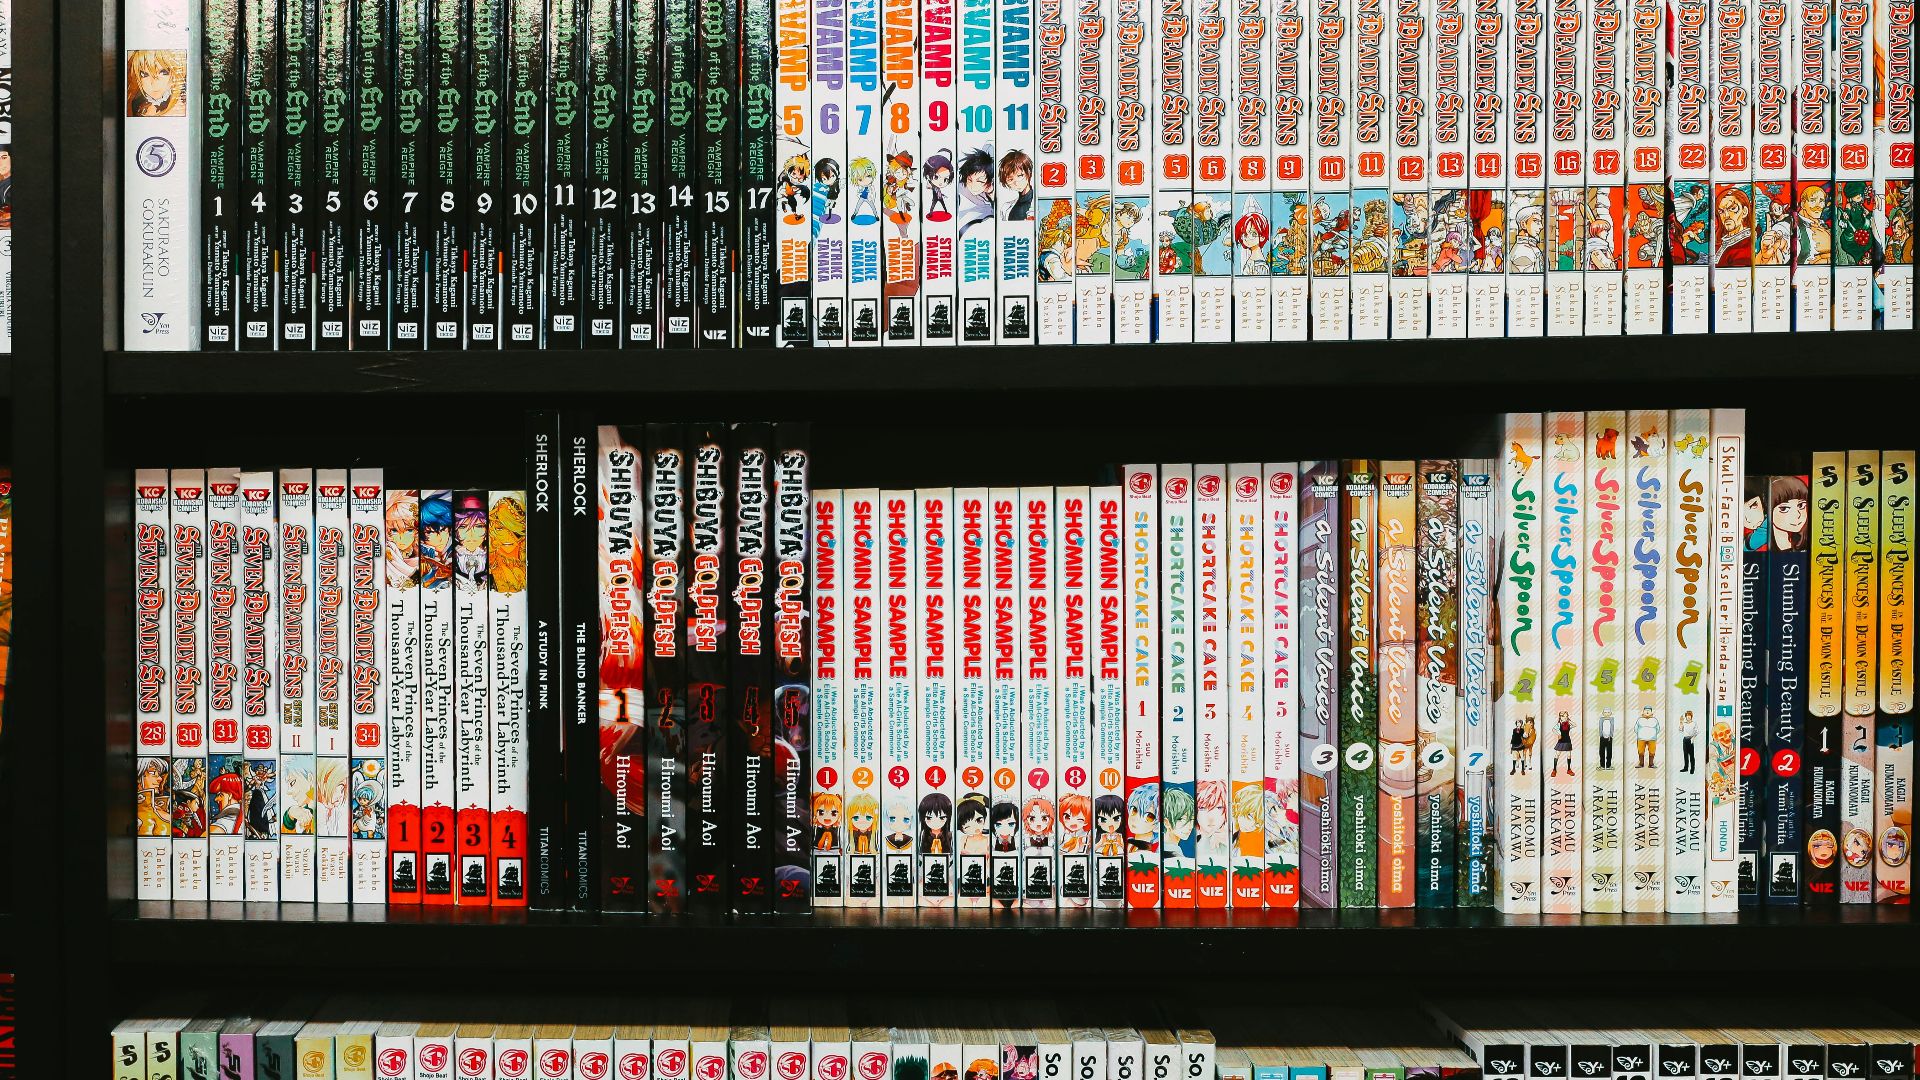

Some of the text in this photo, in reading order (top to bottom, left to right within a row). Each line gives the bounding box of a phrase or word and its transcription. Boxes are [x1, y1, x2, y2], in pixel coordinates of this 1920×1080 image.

[1632, 6, 1661, 138] DEADLY SINS
[1038, 24, 1067, 154] DEADLY SINS
[783, 105, 803, 135] 5
[819, 103, 840, 135] 6
[855, 104, 872, 135] 7
[890, 102, 910, 134] 8
[928, 100, 948, 132] 9
[961, 105, 992, 133] 10
[1002, 103, 1029, 130] 11
[144, 144, 166, 171] 5
[563, 133, 571, 178] VAMPIRE
[1323, 160, 1341, 177] 10
[1402, 161, 1420, 176] 12
[1479, 157, 1498, 173] 14
[1639, 151, 1657, 167] 18
[1684, 148, 1703, 163] 22
[1048, 168, 1061, 183] 2
[214, 196, 223, 216] 1
[250, 190, 267, 213] 4
[363, 189, 379, 211] 6
[512, 193, 538, 215] 10
[554, 184, 575, 206] 11
[592, 188, 617, 210] 12
[668, 185, 694, 207] 14
[704, 191, 730, 212] 15
[747, 187, 773, 209] 17
[143, 199, 154, 298] GOKURAKUIN
[158, 199, 169, 276] SAKURAKO
[566, 239, 576, 301] Takaya Kagami
[927, 234, 940, 280] TANAKA
[941, 235, 952, 278] STRIKE
[1003, 237, 1017, 281] TANAKA
[1016, 237, 1029, 278] STRIKE
[559, 261, 567, 306] Yamamoto
[536, 434, 548, 512] SHERLOCK
[574, 436, 586, 516] SHERLOCK
[1720, 446, 1736, 529] Skull-face
[144, 488, 160, 497] KC
[1817, 498, 1841, 550] SLEEPY
[606, 448, 638, 656] SHIBUYA GOLDFISH
[691, 446, 724, 652] SHIBUYA GOLDFISH
[1508, 476, 1537, 657] Silver Spoon
[1816, 551, 1838, 610] PRINCESS
[816, 499, 836, 680] SHOMIN SAMPLE
[924, 499, 945, 680] SHOMIN SAMPLE
[1134, 510, 1150, 687] SHORTCAKE CAKE
[138, 523, 165, 713] SEVEN DEADLY SINS
[539, 620, 547, 628] A
[1314, 519, 1338, 726] a Silent Voice
[539, 631, 547, 666] STUDY
[1776, 563, 1800, 743] Slumbering Beauty
[1820, 627, 1833, 659] DEMON
[511, 642, 523, 685] Seven
[539, 670, 547, 680] IN
[577, 622, 586, 724] THE BLIND BANKER
[1518, 679, 1532, 694] 2
[1685, 671, 1698, 687] 7
[1819, 661, 1833, 698] CASTLE
[496, 605, 510, 793] Thousand-Year Labyrinth
[614, 688, 629, 722] 1
[658, 688, 673, 728] 2
[700, 683, 715, 723] 3
[1138, 700, 1146, 716] 1
[1173, 706, 1183, 722] 2
[217, 723, 234, 738] 31
[511, 689, 523, 744] Princes
[143, 726, 162, 740] 28
[180, 728, 198, 742] 30
[360, 728, 378, 743] 34
[512, 746, 516, 754] of
[1317, 751, 1333, 765] 3
[1351, 750, 1368, 763] 4
[1390, 751, 1406, 764] 5
[1778, 755, 1793, 771] 2
[823, 770, 831, 784] 1
[857, 770, 868, 784] 2
[894, 769, 904, 783] 3
[929, 769, 940, 783] 4
[1103, 771, 1120, 785] 10
[617, 755, 632, 849] Hiroumi Aoi
[662, 758, 676, 851] Hiroumi Aoi
[1813, 767, 1823, 819] KUMANOMATA
[1826, 780, 1834, 805] KAGIJI
[1510, 794, 1521, 862] ARAKAWA
[1524, 798, 1535, 859] HIROMU
[1778, 783, 1788, 845] Yumi Unita
[398, 821, 408, 843] 1
[429, 821, 445, 844] 2
[466, 824, 481, 847] 3
[501, 825, 517, 850] 4
[1354, 795, 1366, 891] yoshitoki oima
[540, 827, 550, 894] TITANCOMICS
[1132, 883, 1155, 893] VIZ
[1845, 881, 1870, 891] VIZ
